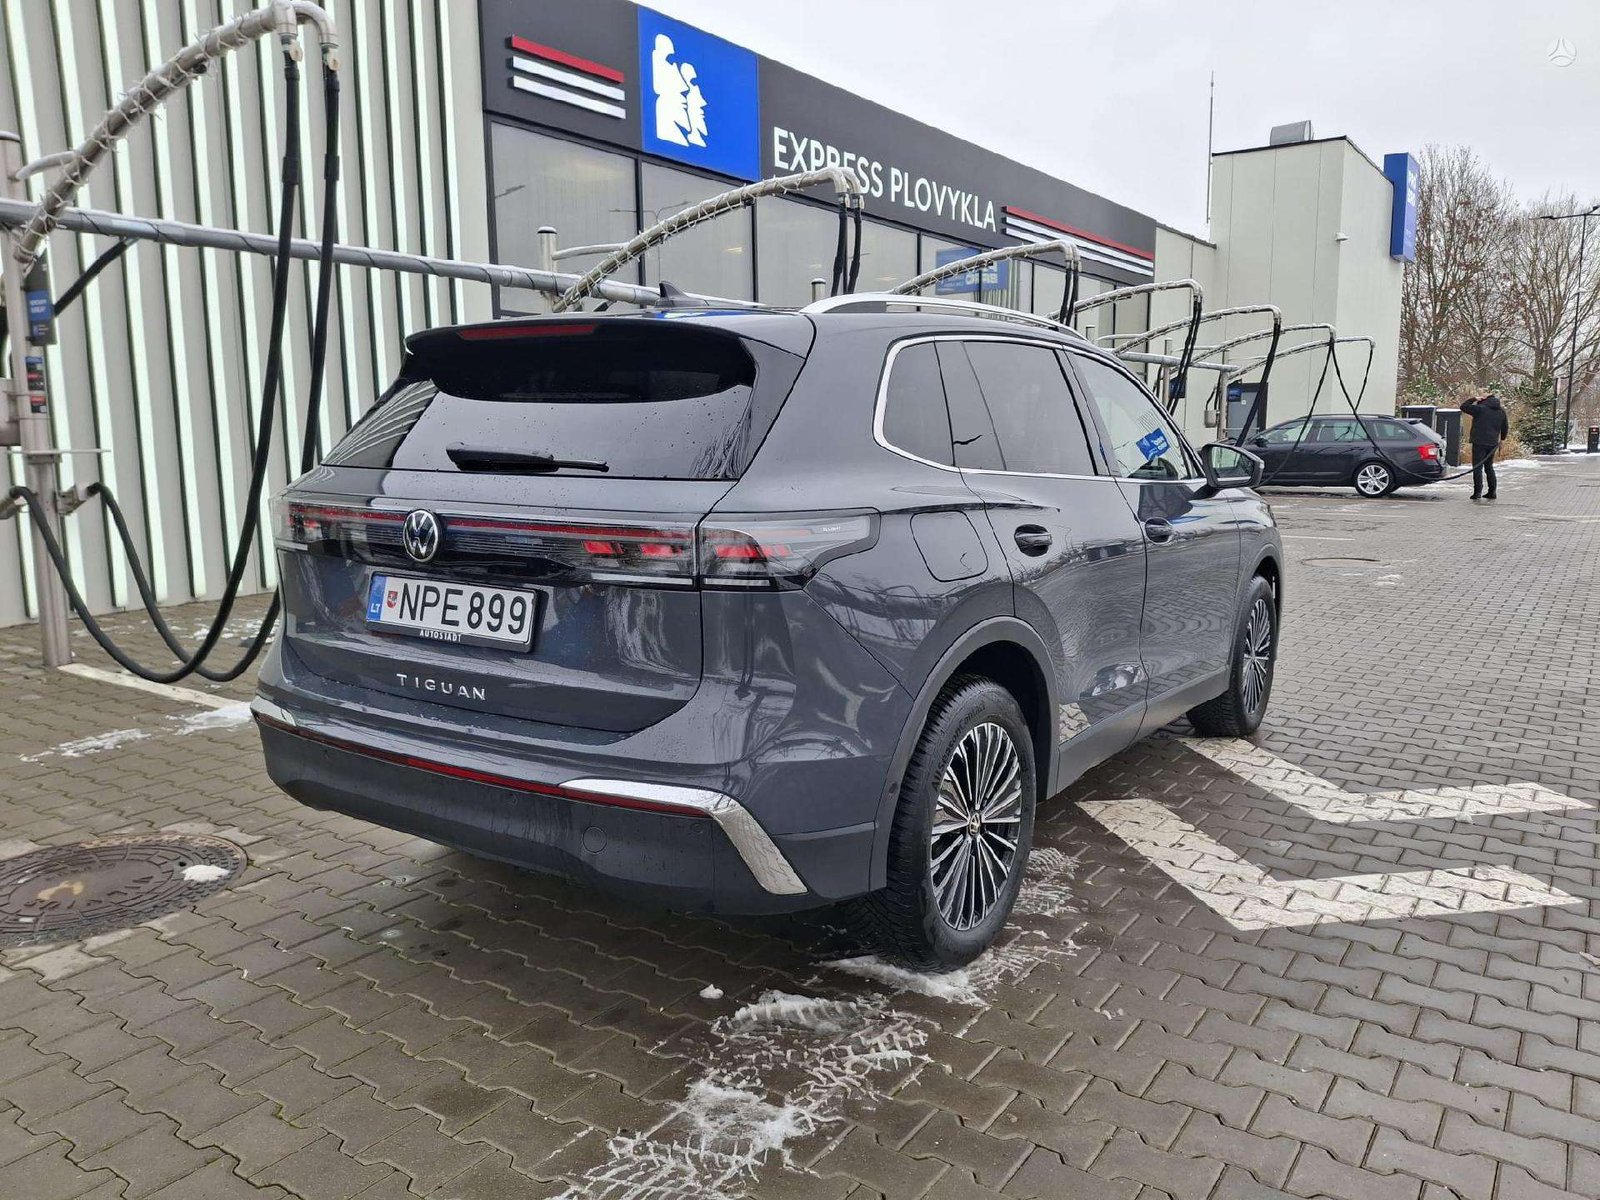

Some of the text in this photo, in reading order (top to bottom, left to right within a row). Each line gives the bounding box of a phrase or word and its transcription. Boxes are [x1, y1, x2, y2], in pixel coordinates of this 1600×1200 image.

[890, 167, 997, 233] PLOVYKLA
[370, 603, 381, 613] LT
[399, 583, 527, 635] NPE 899
[419, 629, 462, 643] AUTOSTADT
[396, 673, 486, 701] TIGUAN
